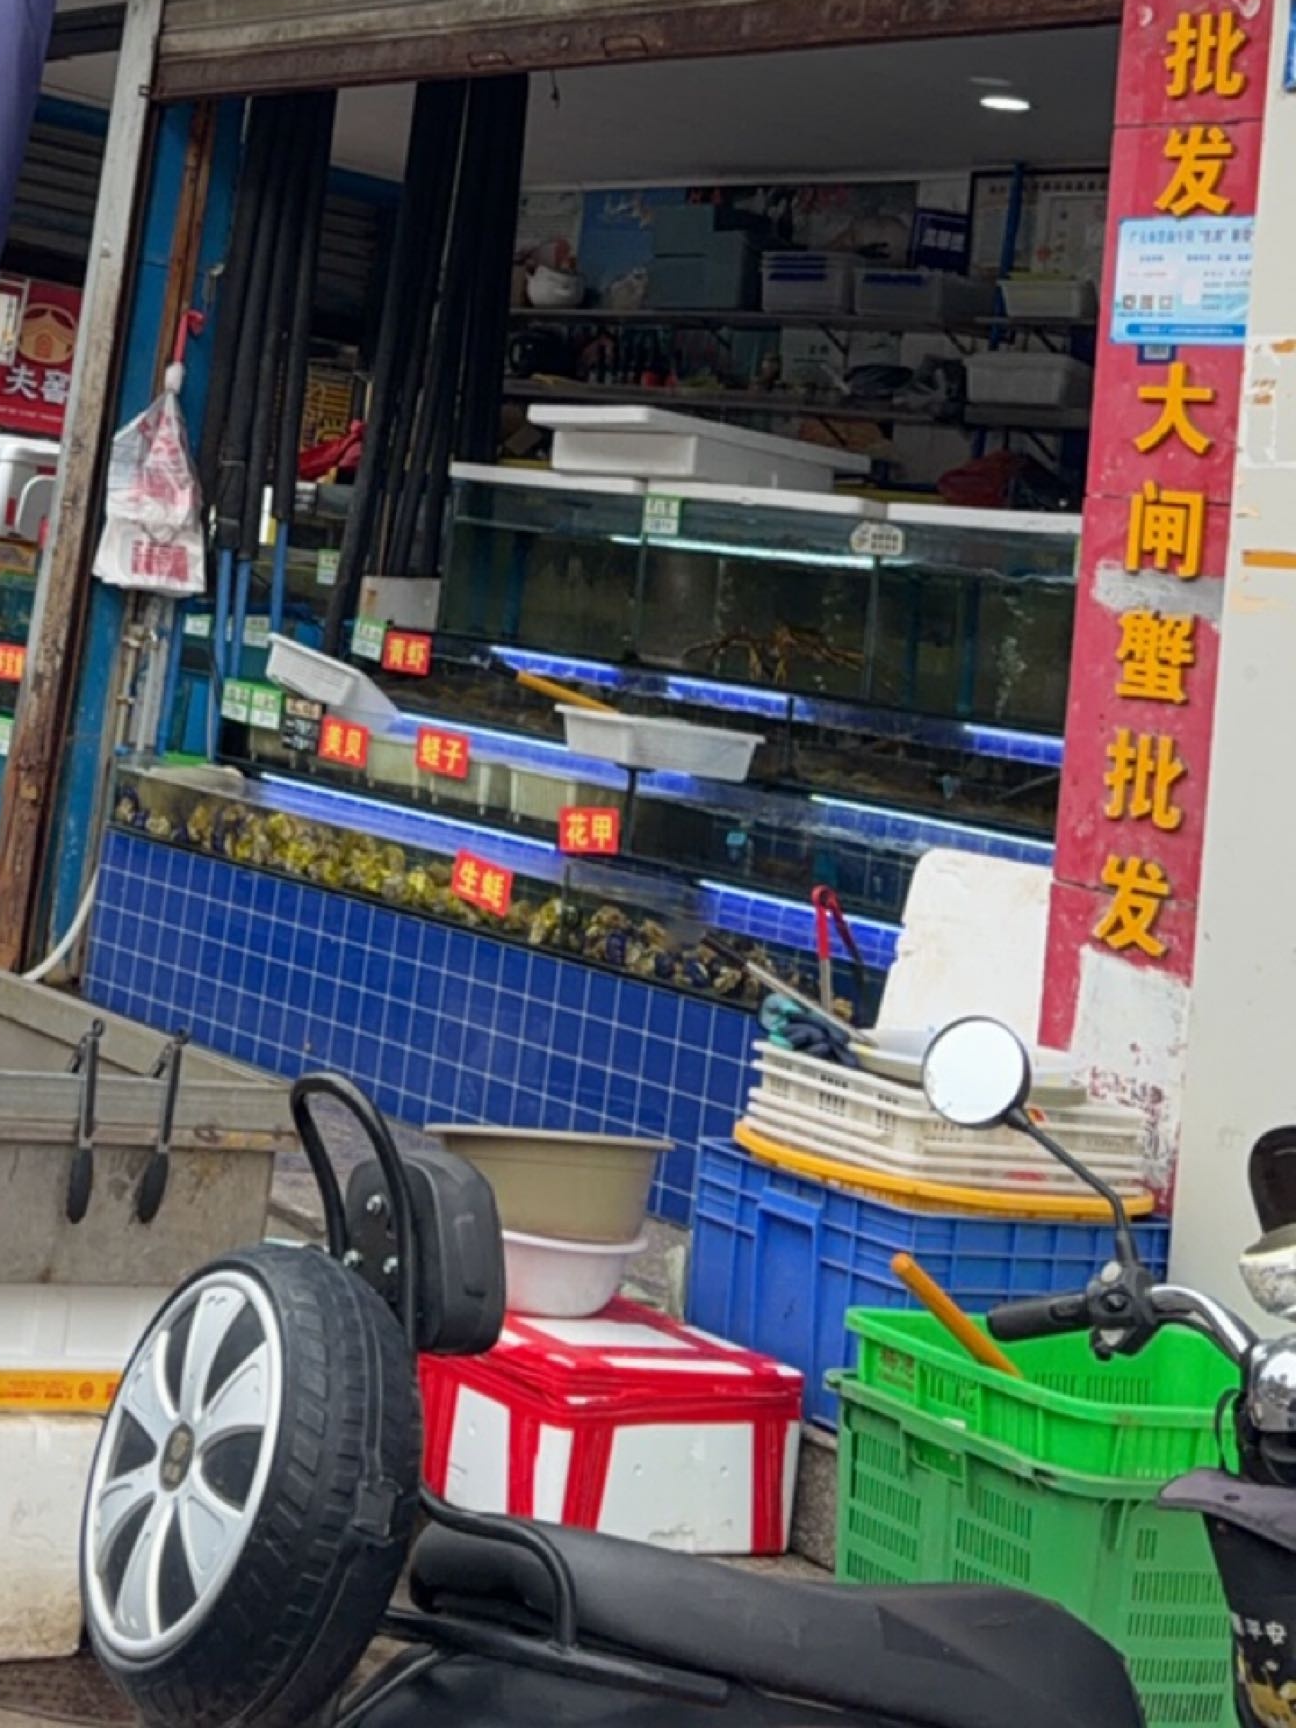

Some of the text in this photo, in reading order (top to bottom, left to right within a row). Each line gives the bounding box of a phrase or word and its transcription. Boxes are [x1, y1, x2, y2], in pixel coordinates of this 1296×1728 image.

[1093, 360, 1215, 959] 大闸蟹批发
[566, 812, 613, 850] 花甲
[456, 860, 505, 909] 生蚝
